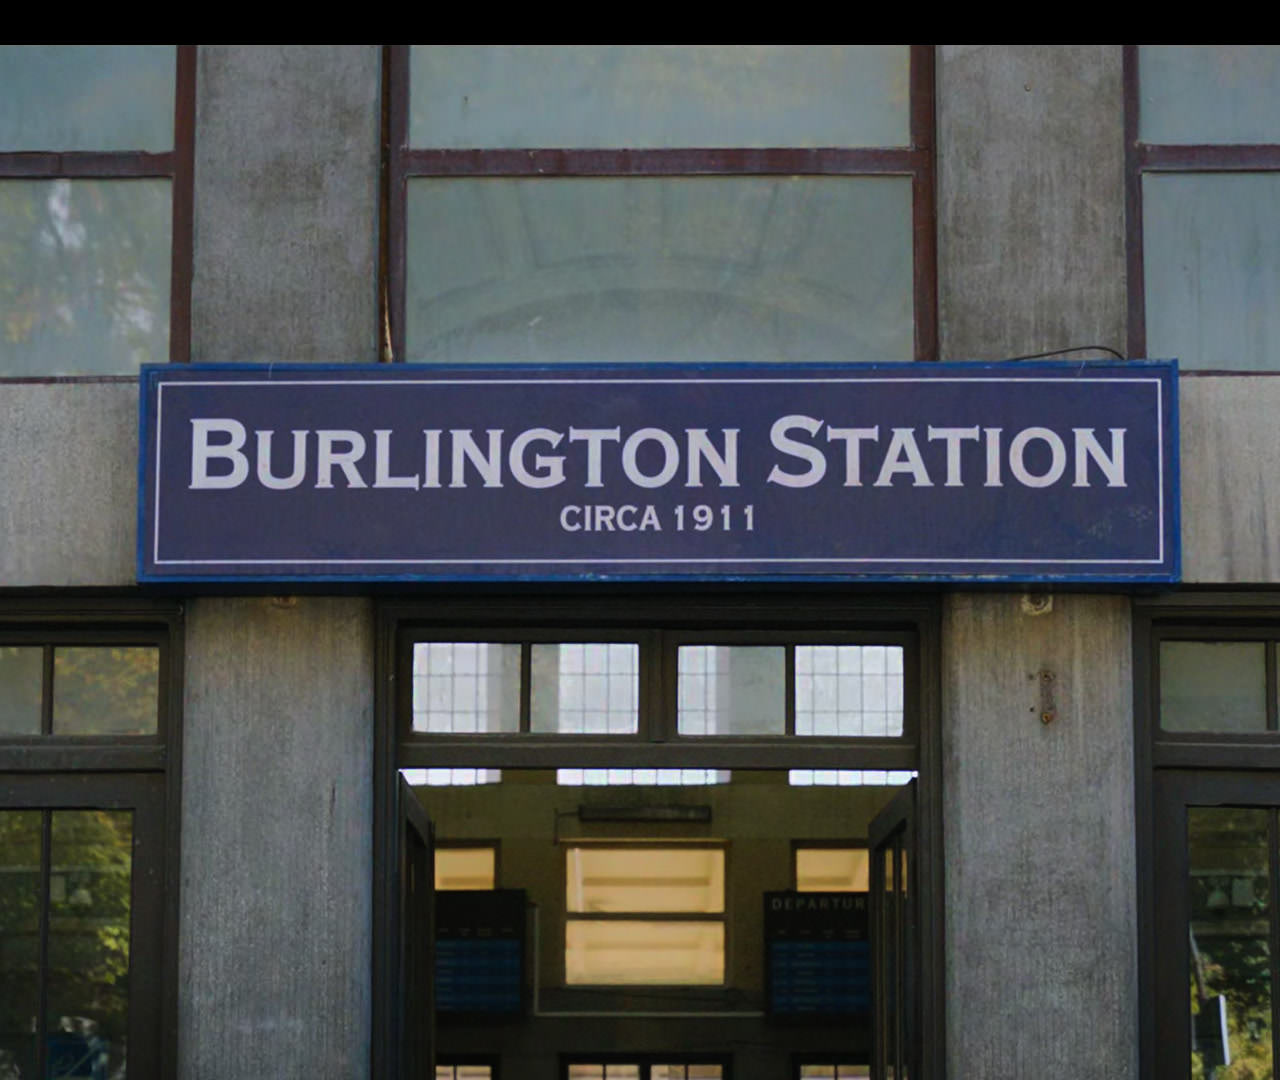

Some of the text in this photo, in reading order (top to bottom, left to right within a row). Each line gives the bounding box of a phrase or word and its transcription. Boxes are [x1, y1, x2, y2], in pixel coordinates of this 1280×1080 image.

[559, 504, 754, 532] CIRCA 1911
[771, 896, 865, 912] DEPARTUR
